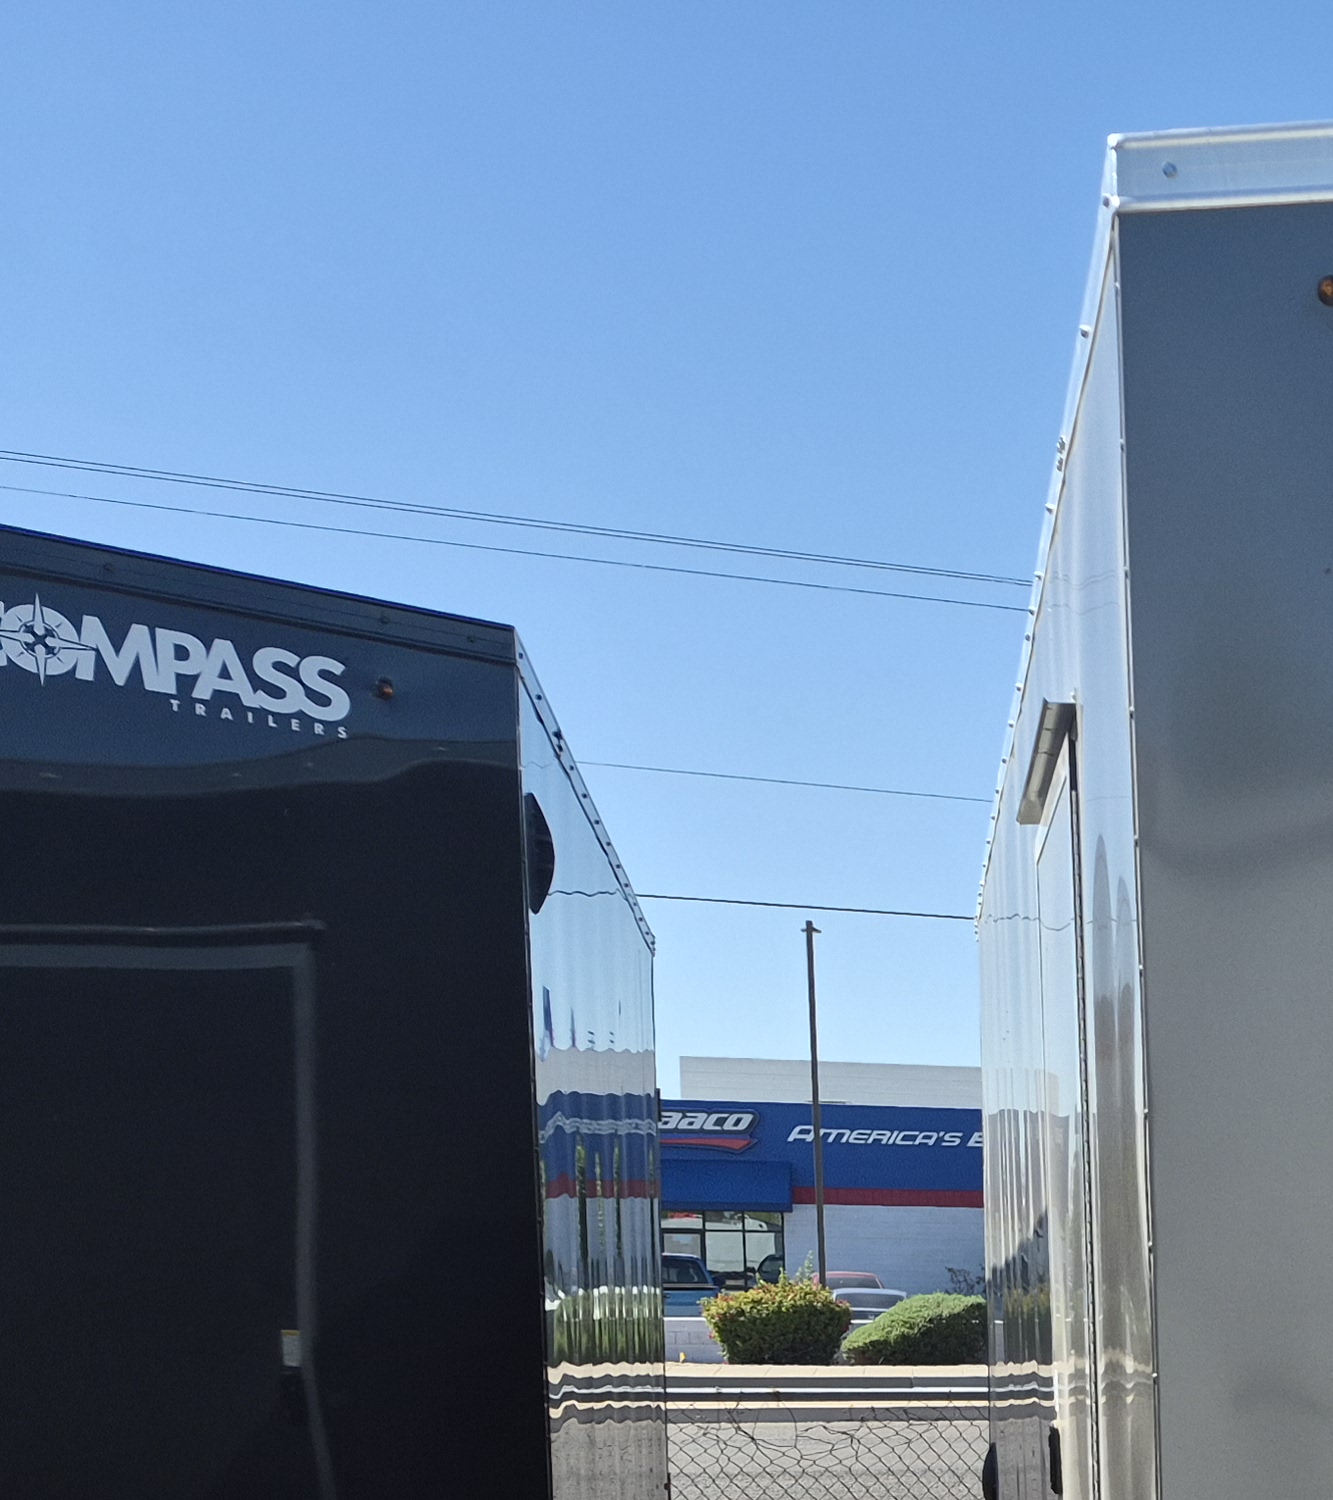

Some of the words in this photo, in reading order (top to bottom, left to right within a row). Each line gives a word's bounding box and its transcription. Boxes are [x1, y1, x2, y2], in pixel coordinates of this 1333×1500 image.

[0, 603, 350, 721] OMPASS
[170, 699, 348, 739] TRAILERS
[658, 1112, 754, 1131] aaco
